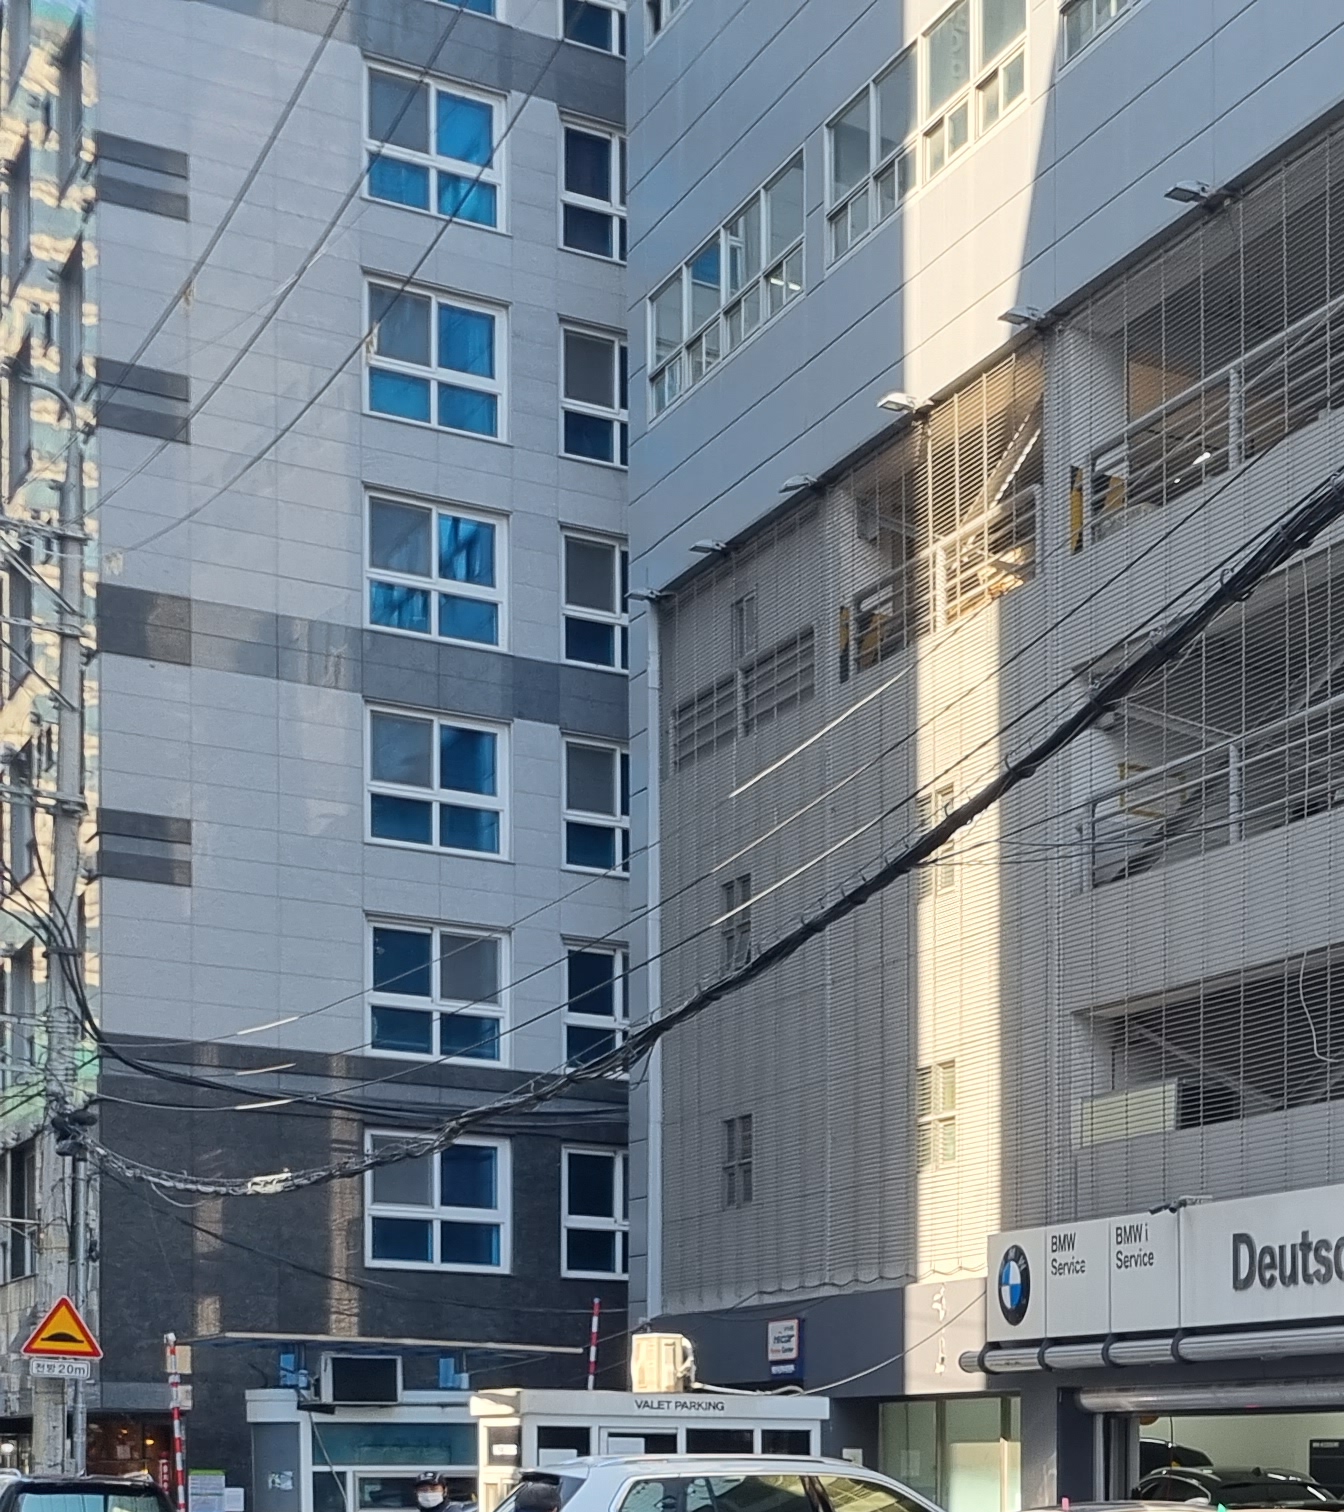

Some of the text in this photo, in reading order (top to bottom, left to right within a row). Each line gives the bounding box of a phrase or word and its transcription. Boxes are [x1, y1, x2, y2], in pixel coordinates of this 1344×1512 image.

[1051, 1232, 1076, 1253] BMW
[1115, 1224, 1143, 1246] BMW
[1051, 1256, 1086, 1276] Service
[1115, 1248, 1154, 1270] Service
[634, 1400, 725, 1411] VALET PARKING
